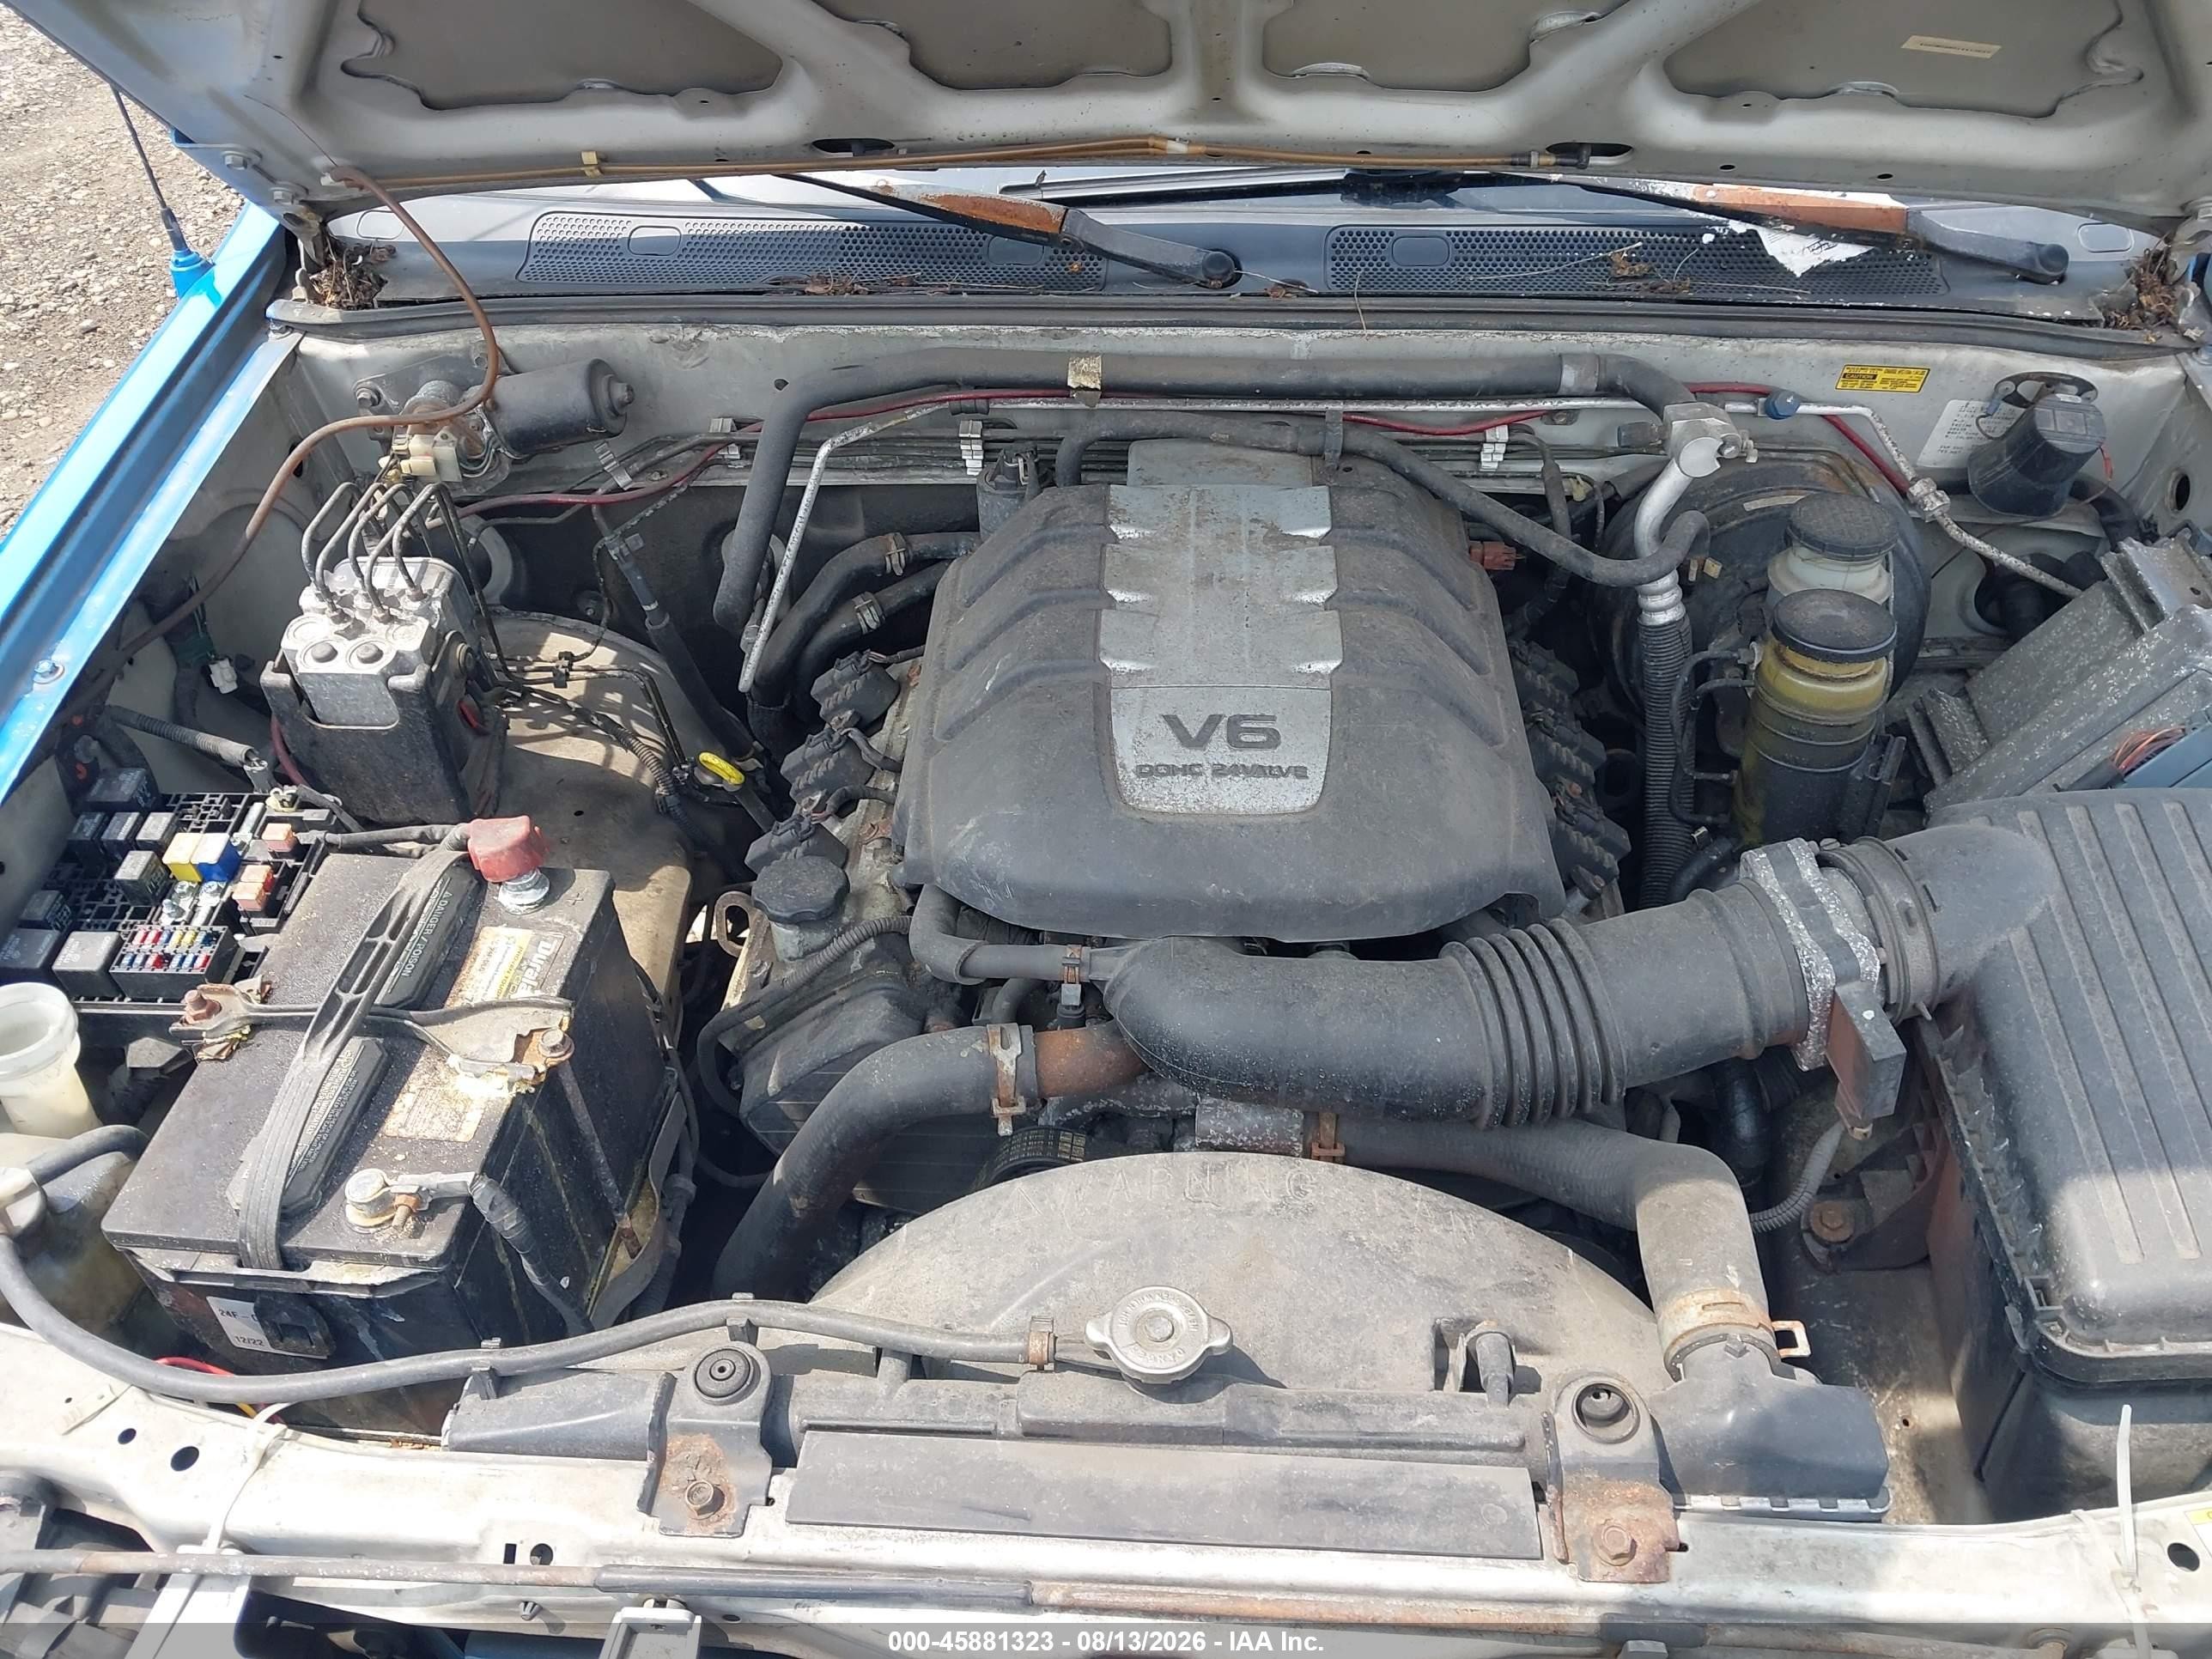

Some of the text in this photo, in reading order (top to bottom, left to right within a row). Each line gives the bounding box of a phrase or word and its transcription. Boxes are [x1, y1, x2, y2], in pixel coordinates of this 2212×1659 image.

[1162, 714, 1281, 750] V6
[1135, 764, 1204, 778] DOHC
[422, 900, 448, 934] DANGER
[401, 943, 425, 975] POISON
[513, 939, 557, 1000] Durala
[1128, 1341, 1186, 1364] DANGER
